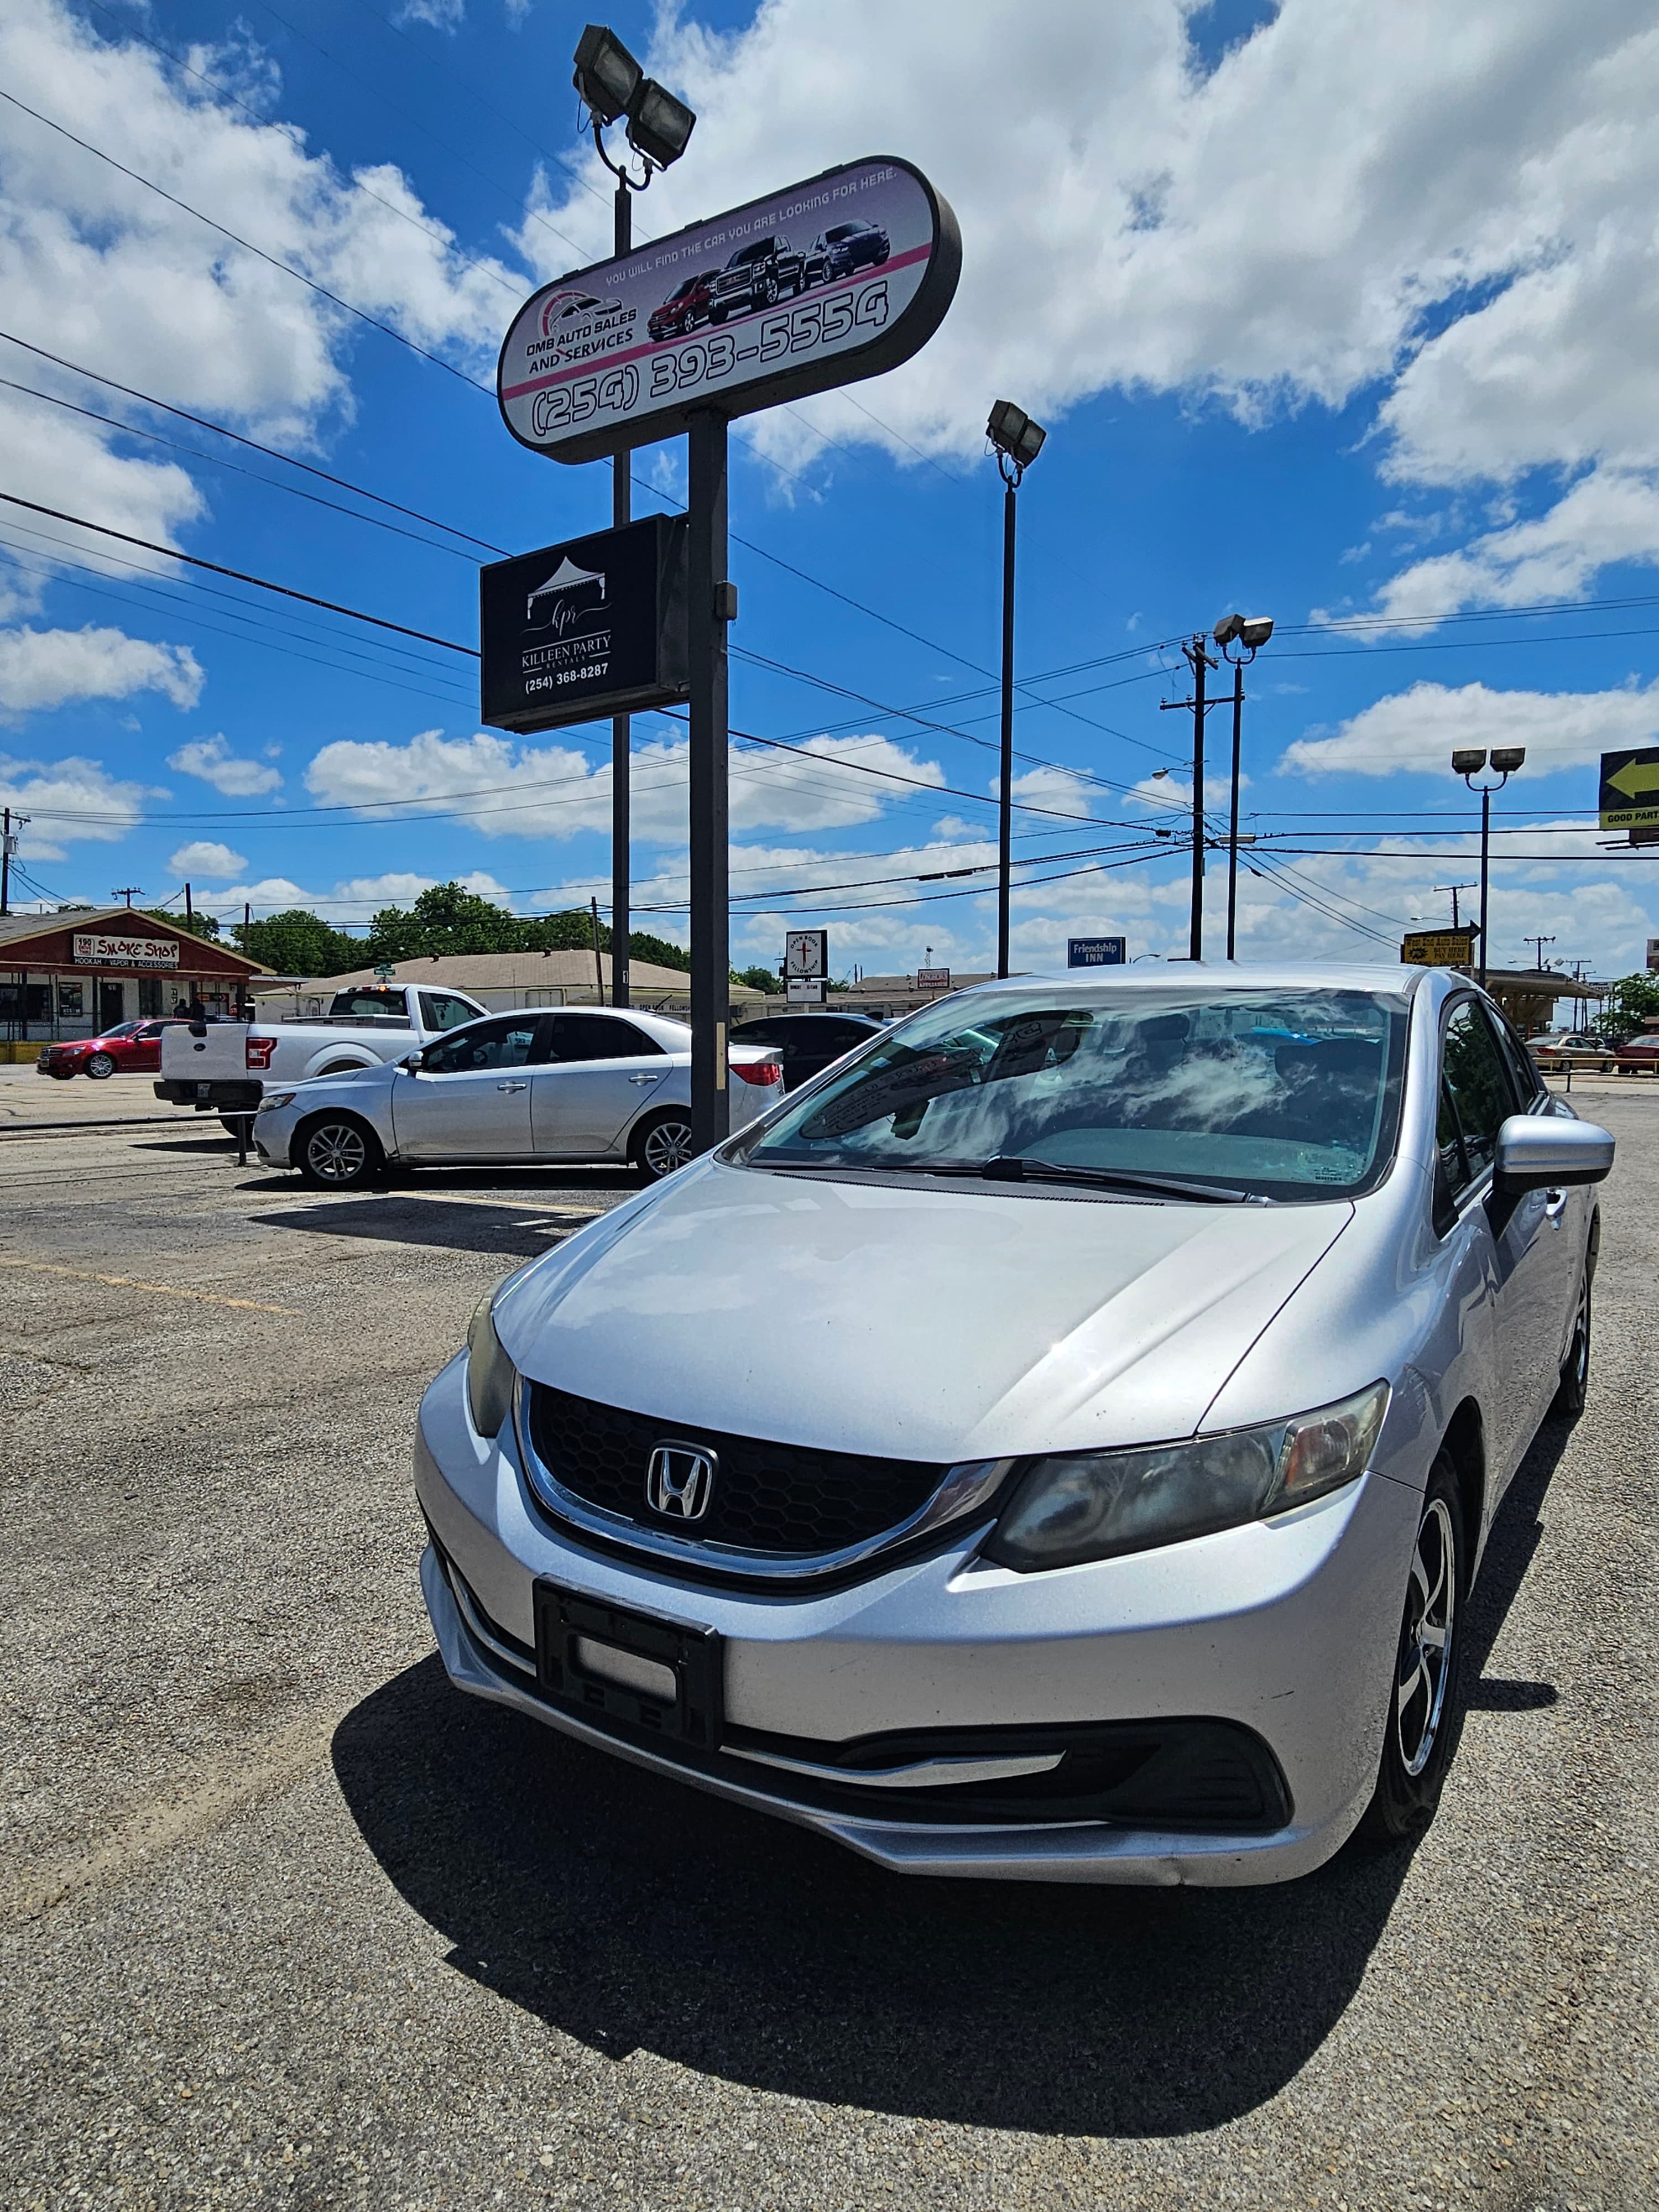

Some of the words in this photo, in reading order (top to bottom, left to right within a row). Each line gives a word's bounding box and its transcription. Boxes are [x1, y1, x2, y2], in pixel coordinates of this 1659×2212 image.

[606, 271, 626, 286] YOU
[628, 262, 653, 278] WILL
[655, 251, 679, 268] FIND
[681, 242, 702, 258] THE
[704, 233, 726, 249] CAR
[729, 223, 751, 237] YOU
[754, 213, 776, 231] ARE
[779, 193, 830, 221] LOOKING
[832, 181, 857, 201] FOR
[860, 167, 897, 190] HERE.
[557, 325, 592, 347] AUTO
[594, 308, 637, 334] SALES
[529, 354, 560, 374] AND
[564, 328, 633, 362] SERVICES
[532, 364, 640, 437] (254)
[650, 280, 890, 398] 393-5554
[522, 645, 570, 667] KILLEEN
[573, 635, 611, 655] PARTY
[525, 675, 553, 695] (254)
[556, 663, 608, 685] 368-8287
[1608, 813, 1632, 823] GOOD
[1635, 810, 1659, 821] PART
[790, 936, 803, 949] OPEN
[805, 935, 818, 947] BOOK
[1073, 942, 1117, 954] Friendship
[138, 961, 178, 969] ACCESSORIES
[1086, 953, 1104, 962] INN
[790, 959, 818, 974] FELLOWSHIP
[623, 971, 628, 983] 1
